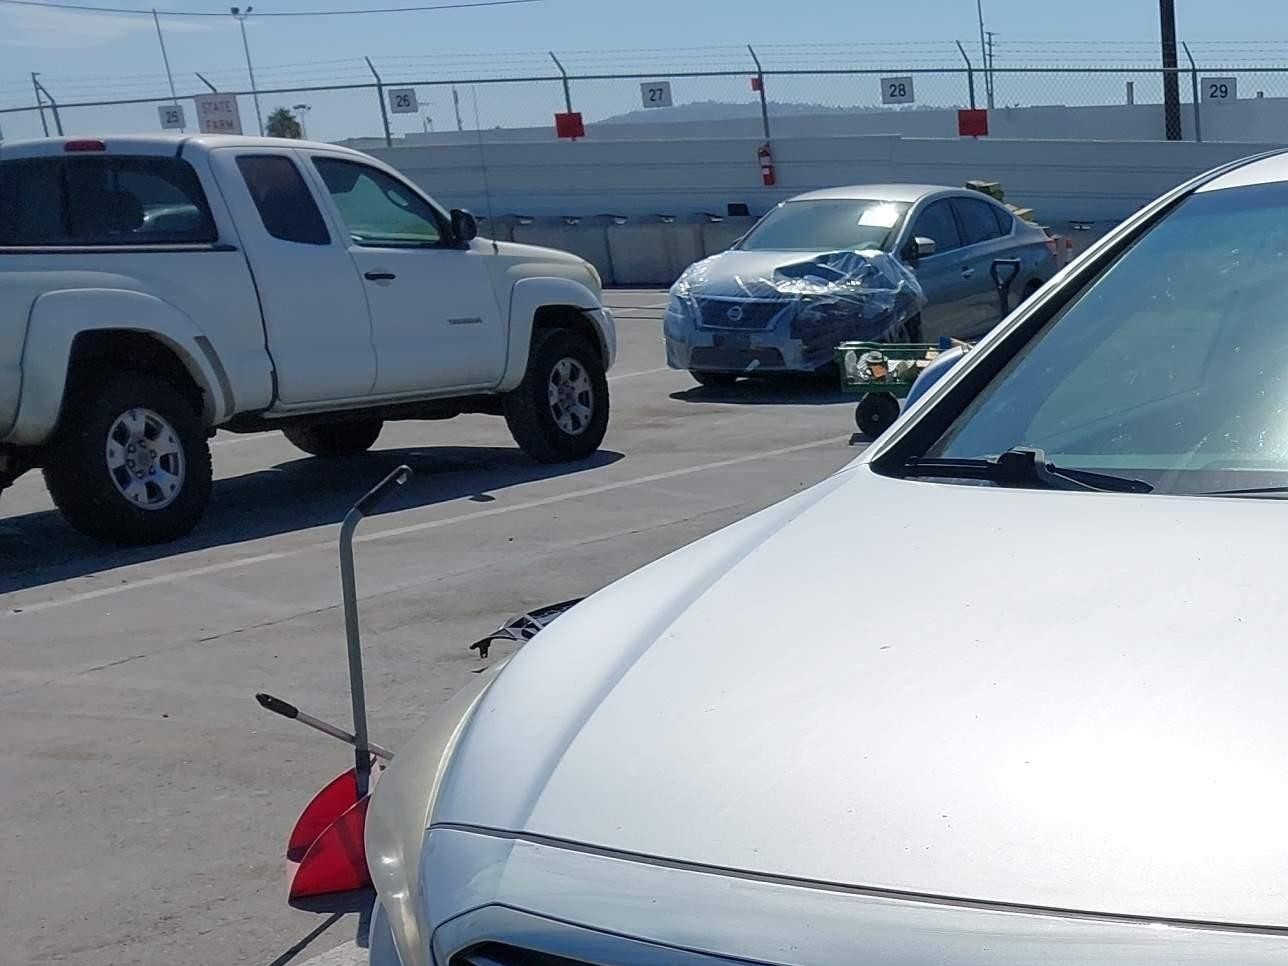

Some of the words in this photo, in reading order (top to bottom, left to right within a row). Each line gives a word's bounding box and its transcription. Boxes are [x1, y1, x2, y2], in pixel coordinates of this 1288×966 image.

[648, 88, 663, 102] 27
[889, 83, 906, 97] 28
[1209, 84, 1228, 99] 29
[201, 100, 232, 114] STATE
[396, 94, 411, 107] 26
[165, 110, 179, 123] 25
[206, 119, 233, 130] FARM
